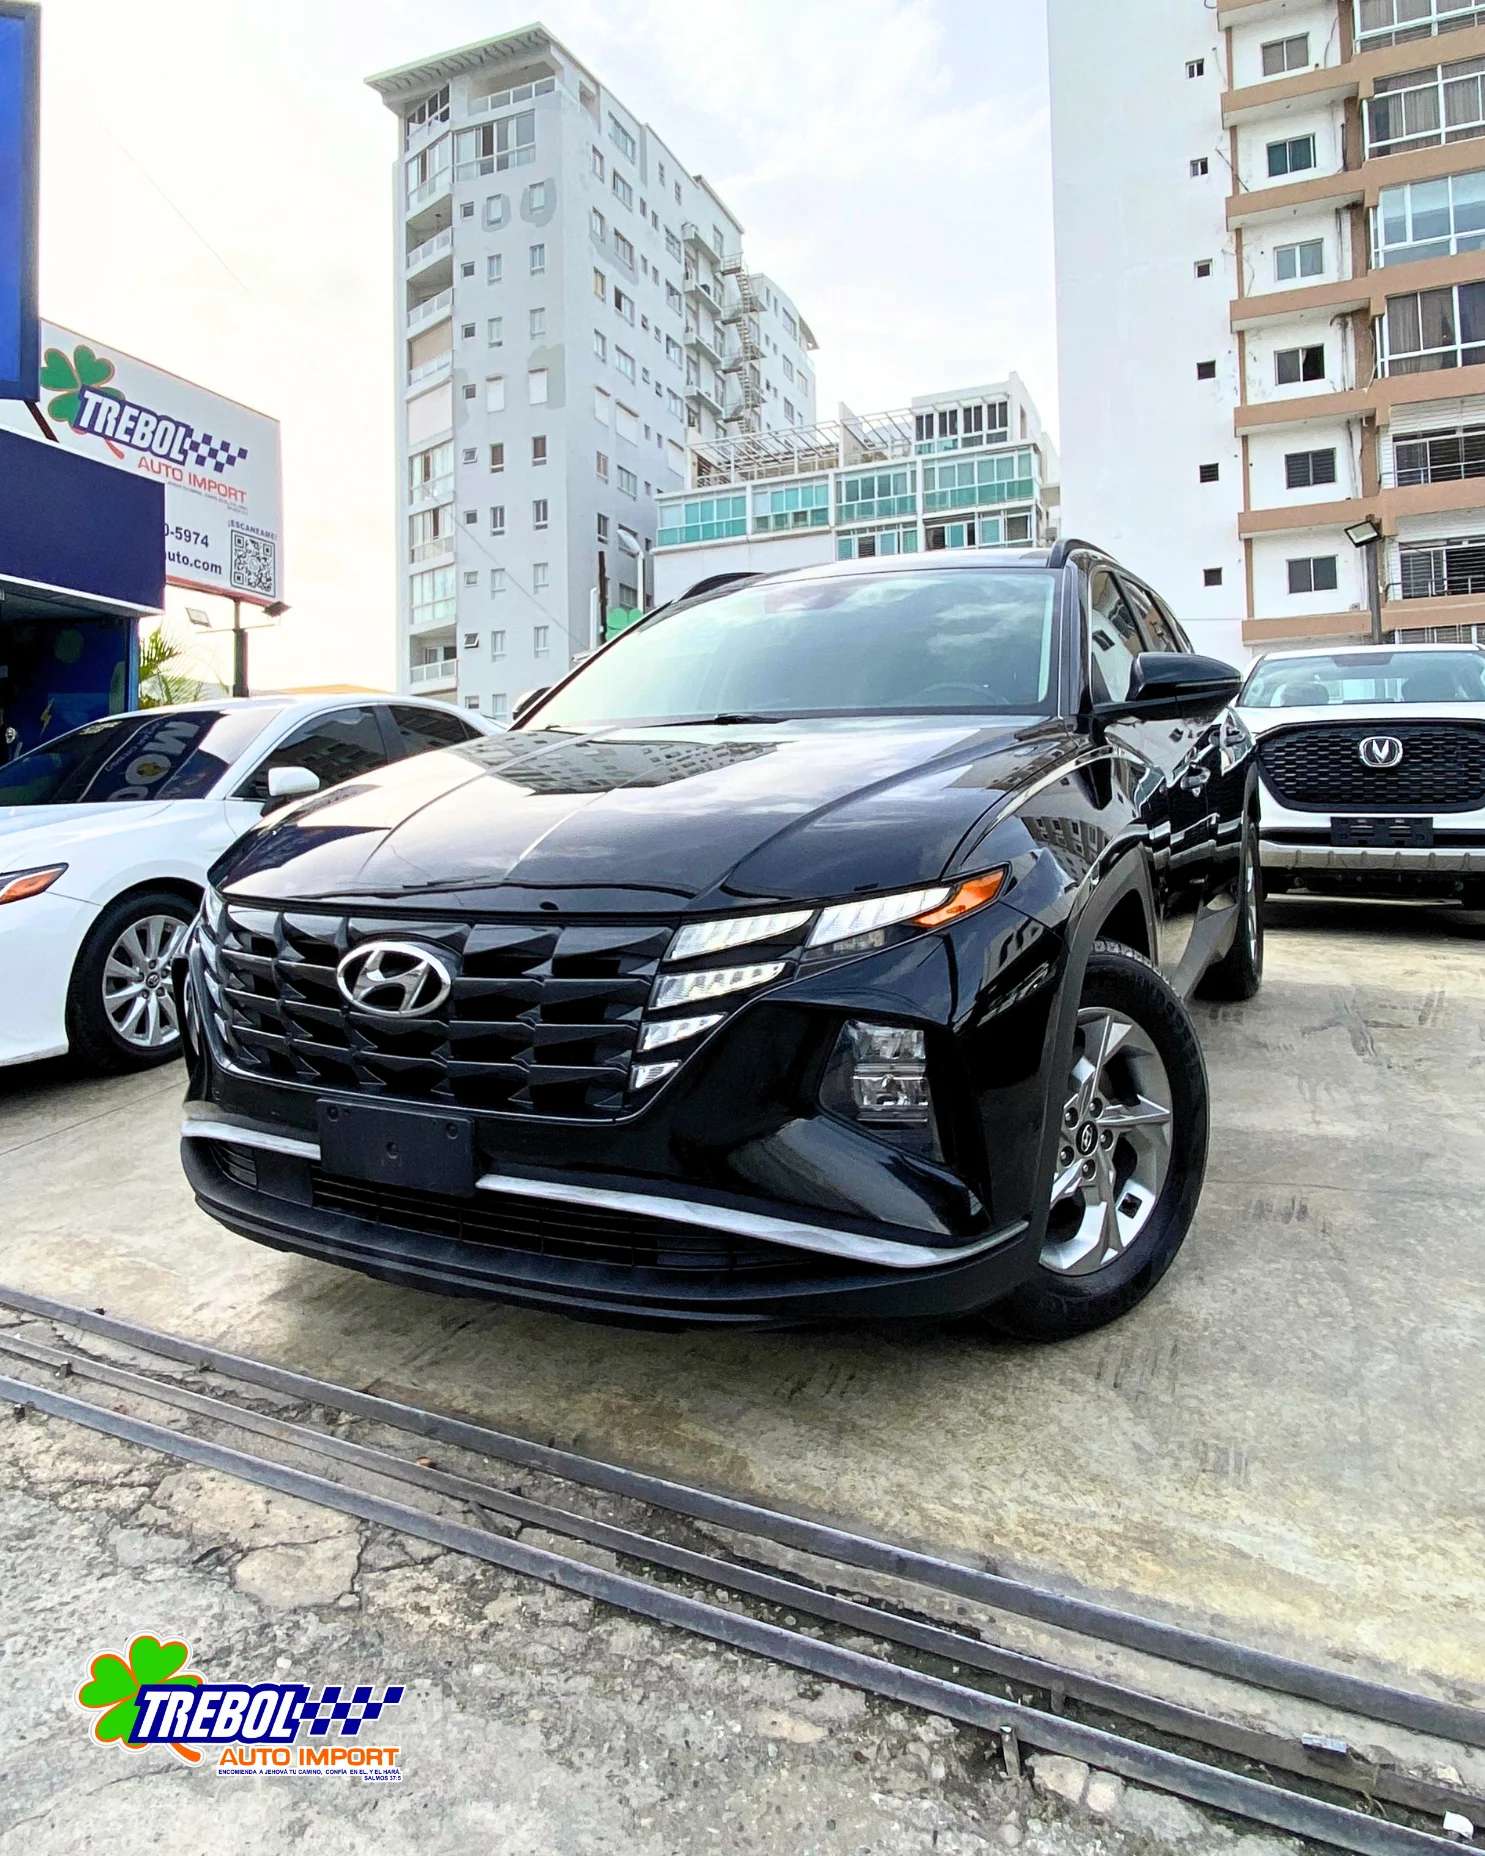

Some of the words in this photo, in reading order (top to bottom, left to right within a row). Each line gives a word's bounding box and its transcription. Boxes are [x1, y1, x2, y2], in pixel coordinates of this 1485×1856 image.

[78, 391, 190, 462] TREBOL
[138, 456, 183, 482] AUTO
[188, 472, 247, 504] IMPORT
[164, 549, 222, 575] uto.com
